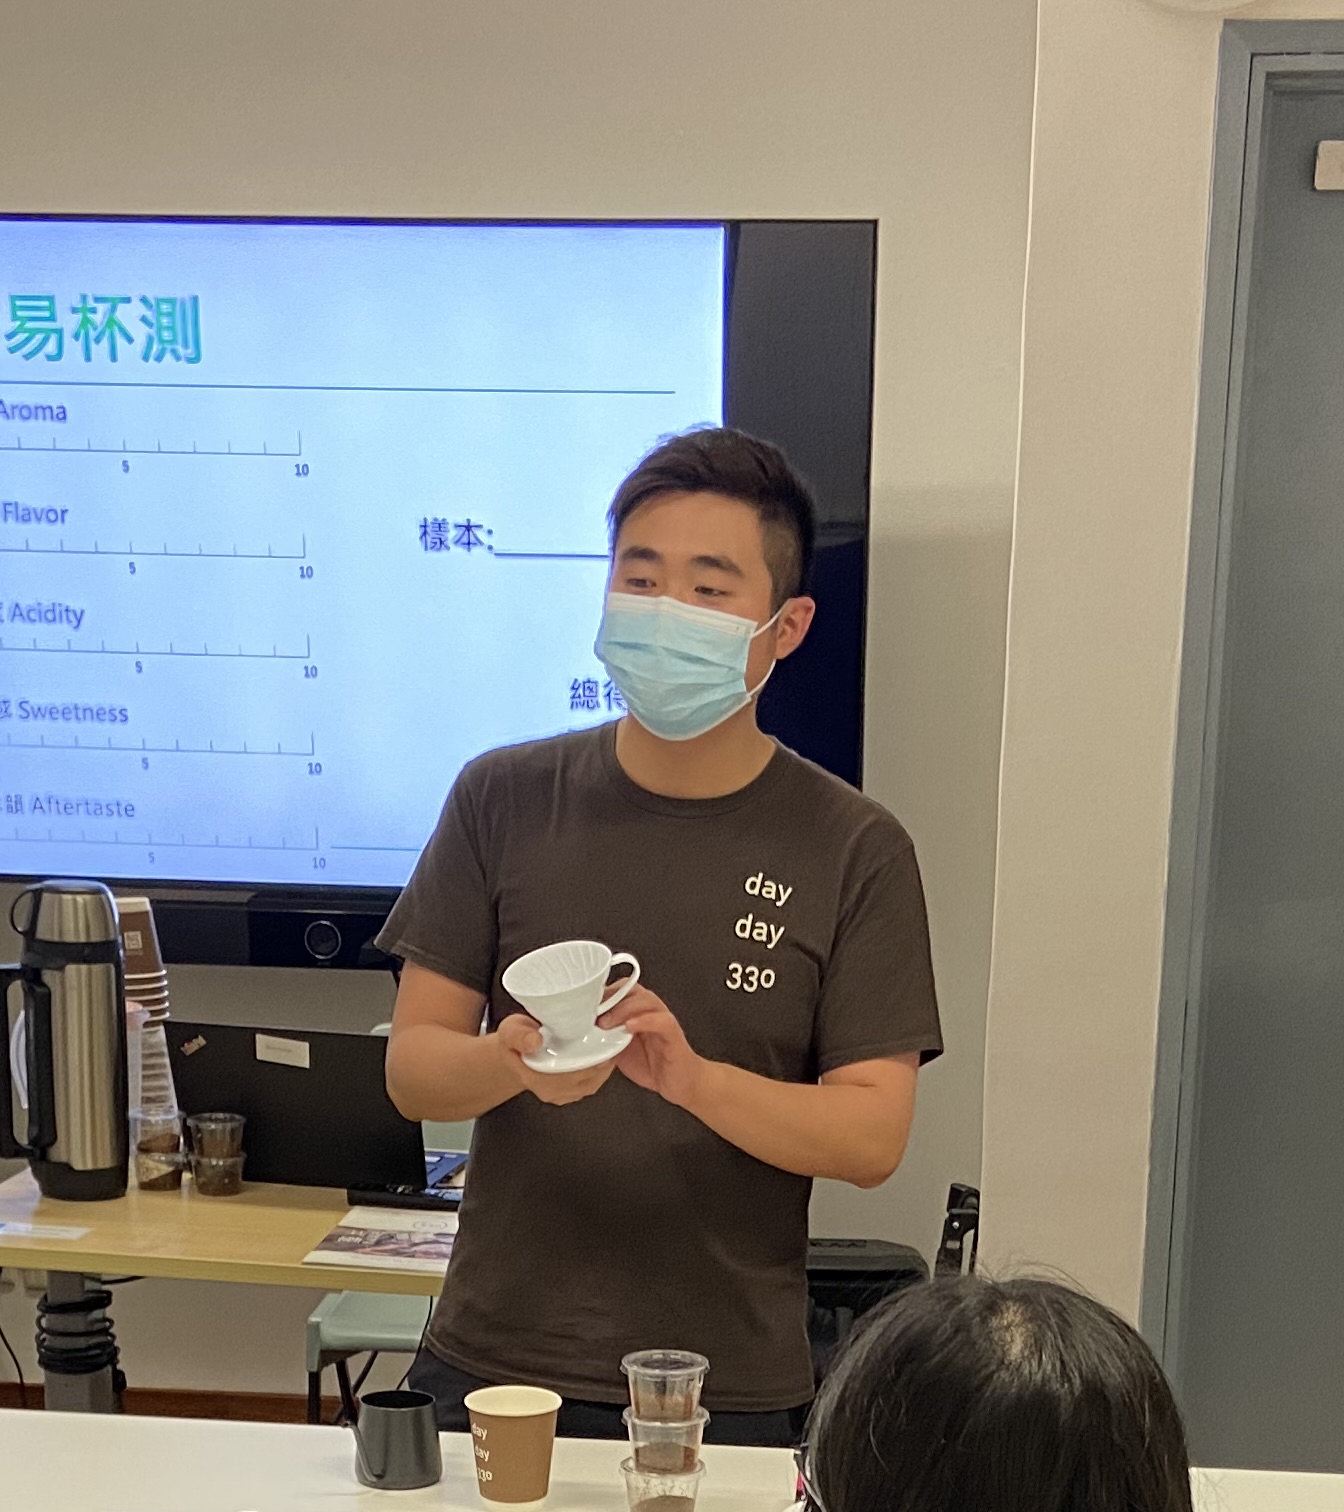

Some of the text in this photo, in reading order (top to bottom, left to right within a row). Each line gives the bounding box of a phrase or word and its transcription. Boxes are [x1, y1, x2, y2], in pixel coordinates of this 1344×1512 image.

[121, 459, 130, 475] 5
[294, 463, 310, 477] 10
[2, 501, 69, 524] Flavor
[128, 561, 137, 576] 5
[298, 565, 314, 580] 10
[9, 602, 85, 630] Acidity
[134, 660, 143, 675] 5
[303, 664, 319, 679] 10
[17, 700, 129, 723] Sweetness
[141, 757, 150, 771] 5
[307, 762, 323, 776] 10
[31, 796, 135, 818] Aftertaste
[147, 851, 156, 864] 5
[312, 857, 327, 870] 10
[744, 871, 793, 907] day
[734, 913, 785, 950] day
